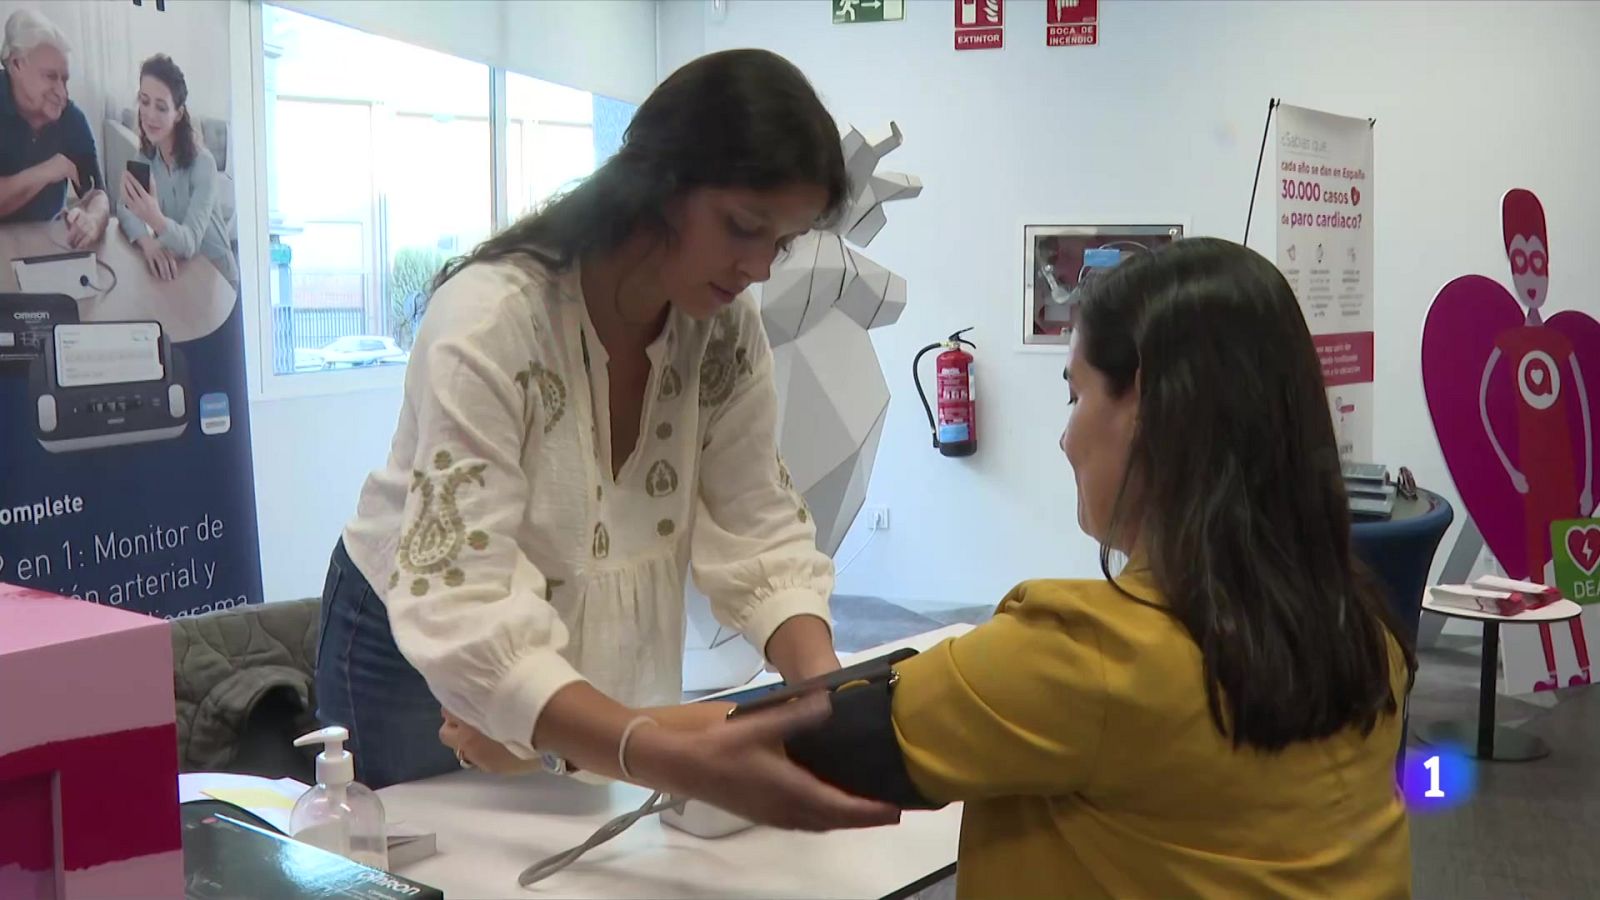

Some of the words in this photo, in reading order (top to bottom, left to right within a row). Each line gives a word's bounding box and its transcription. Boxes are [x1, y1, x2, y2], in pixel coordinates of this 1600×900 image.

[957, 34, 1000, 44] EXTINTOR
[1050, 27, 1076, 35] BOCA
[1081, 26, 1094, 34] DE
[1050, 36, 1094, 45] INCENDIO
[1281, 161, 1296, 172] cada
[1298, 161, 1310, 174] año
[1311, 166, 1319, 175] se
[1320, 164, 1332, 177] dan
[1333, 168, 1341, 177] en
[1342, 167, 1366, 181] España
[1281, 179, 1321, 202] 30.000
[1323, 190, 1349, 205] casos
[1281, 213, 1289, 225] de
[1291, 212, 1313, 229] paro
[0, 495, 84, 525] omplete
[17, 553, 51, 580] en
[62, 540, 85, 570] 1:
[94, 523, 189, 564] Monitor
[196, 513, 224, 542] de
[109, 557, 197, 605] arterial
[203, 561, 217, 589] y
